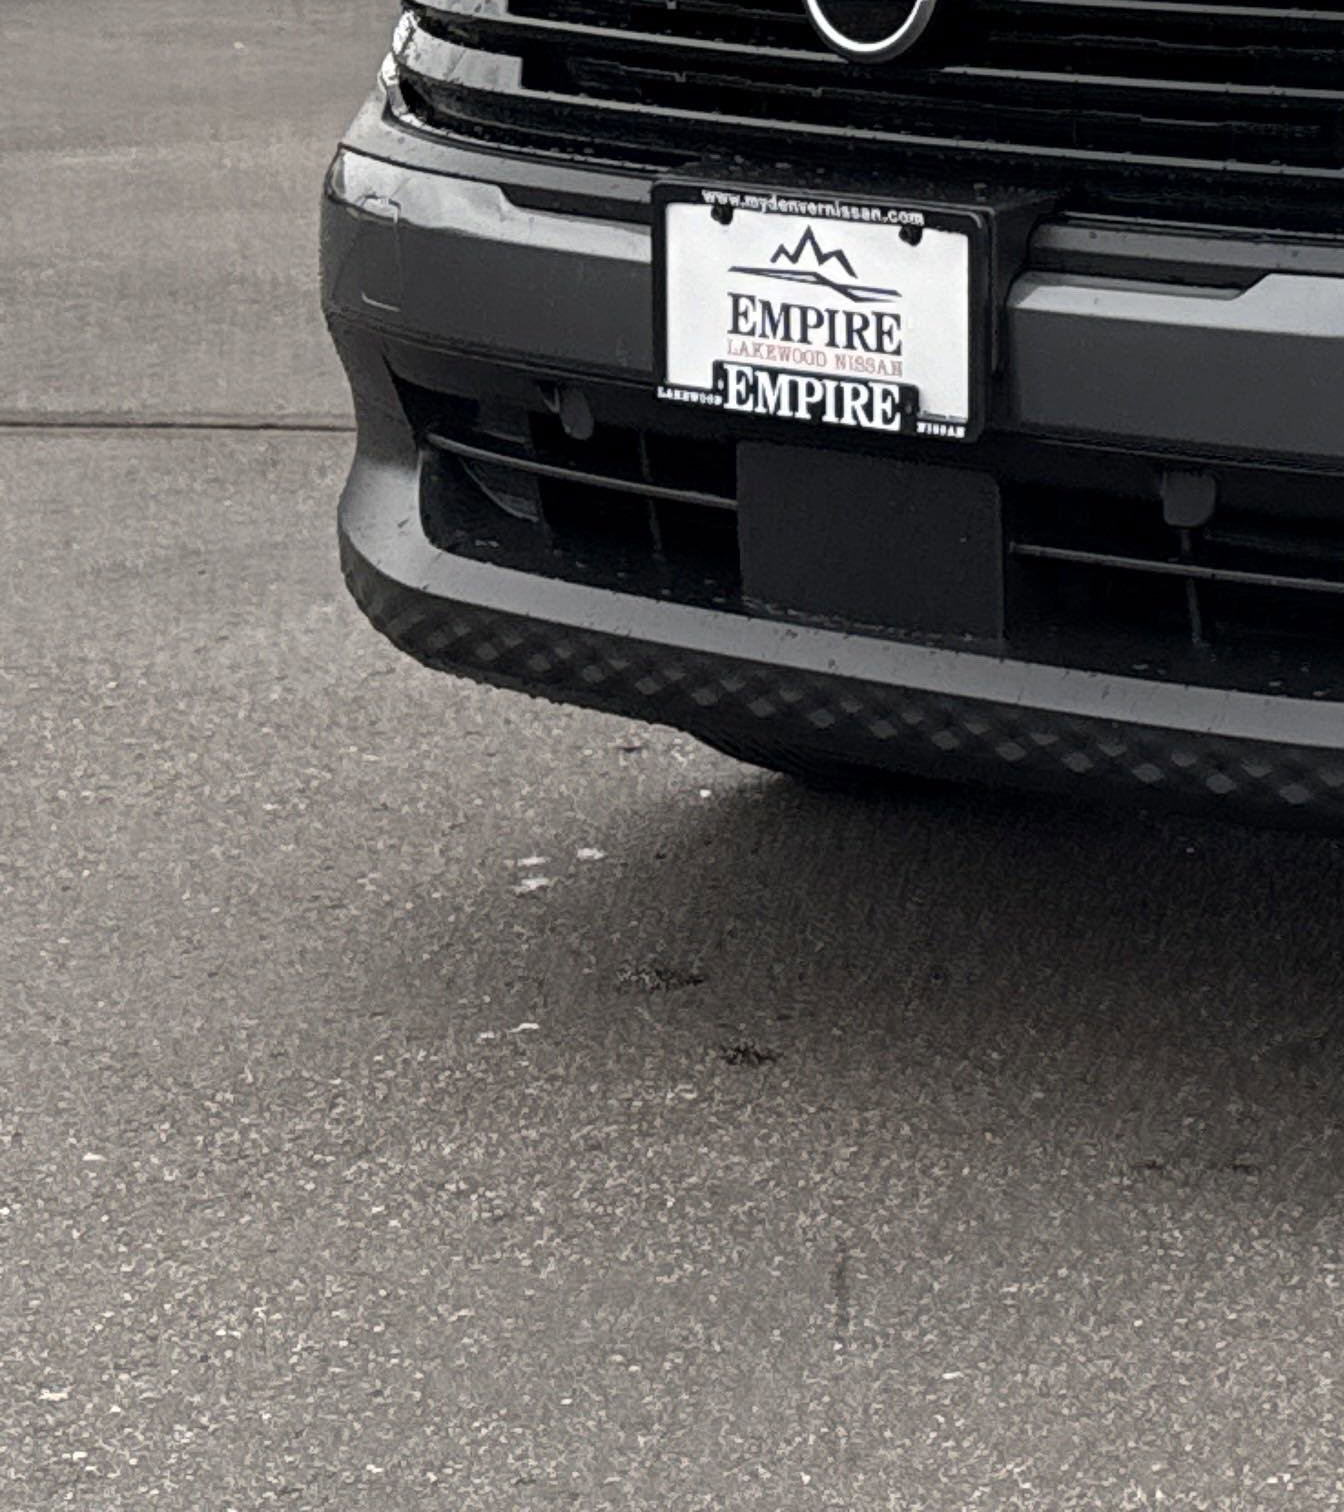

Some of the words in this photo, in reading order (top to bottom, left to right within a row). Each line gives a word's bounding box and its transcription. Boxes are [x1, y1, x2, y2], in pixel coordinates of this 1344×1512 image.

[701, 189, 925, 225] www.mydenvernissan.com
[727, 293, 902, 355] EMPIRE
[727, 339, 828, 367] LAKEWOOD
[834, 354, 903, 378] NISSAN
[657, 386, 723, 405] LAKEWOOD
[724, 365, 900, 431] EMPIRE
